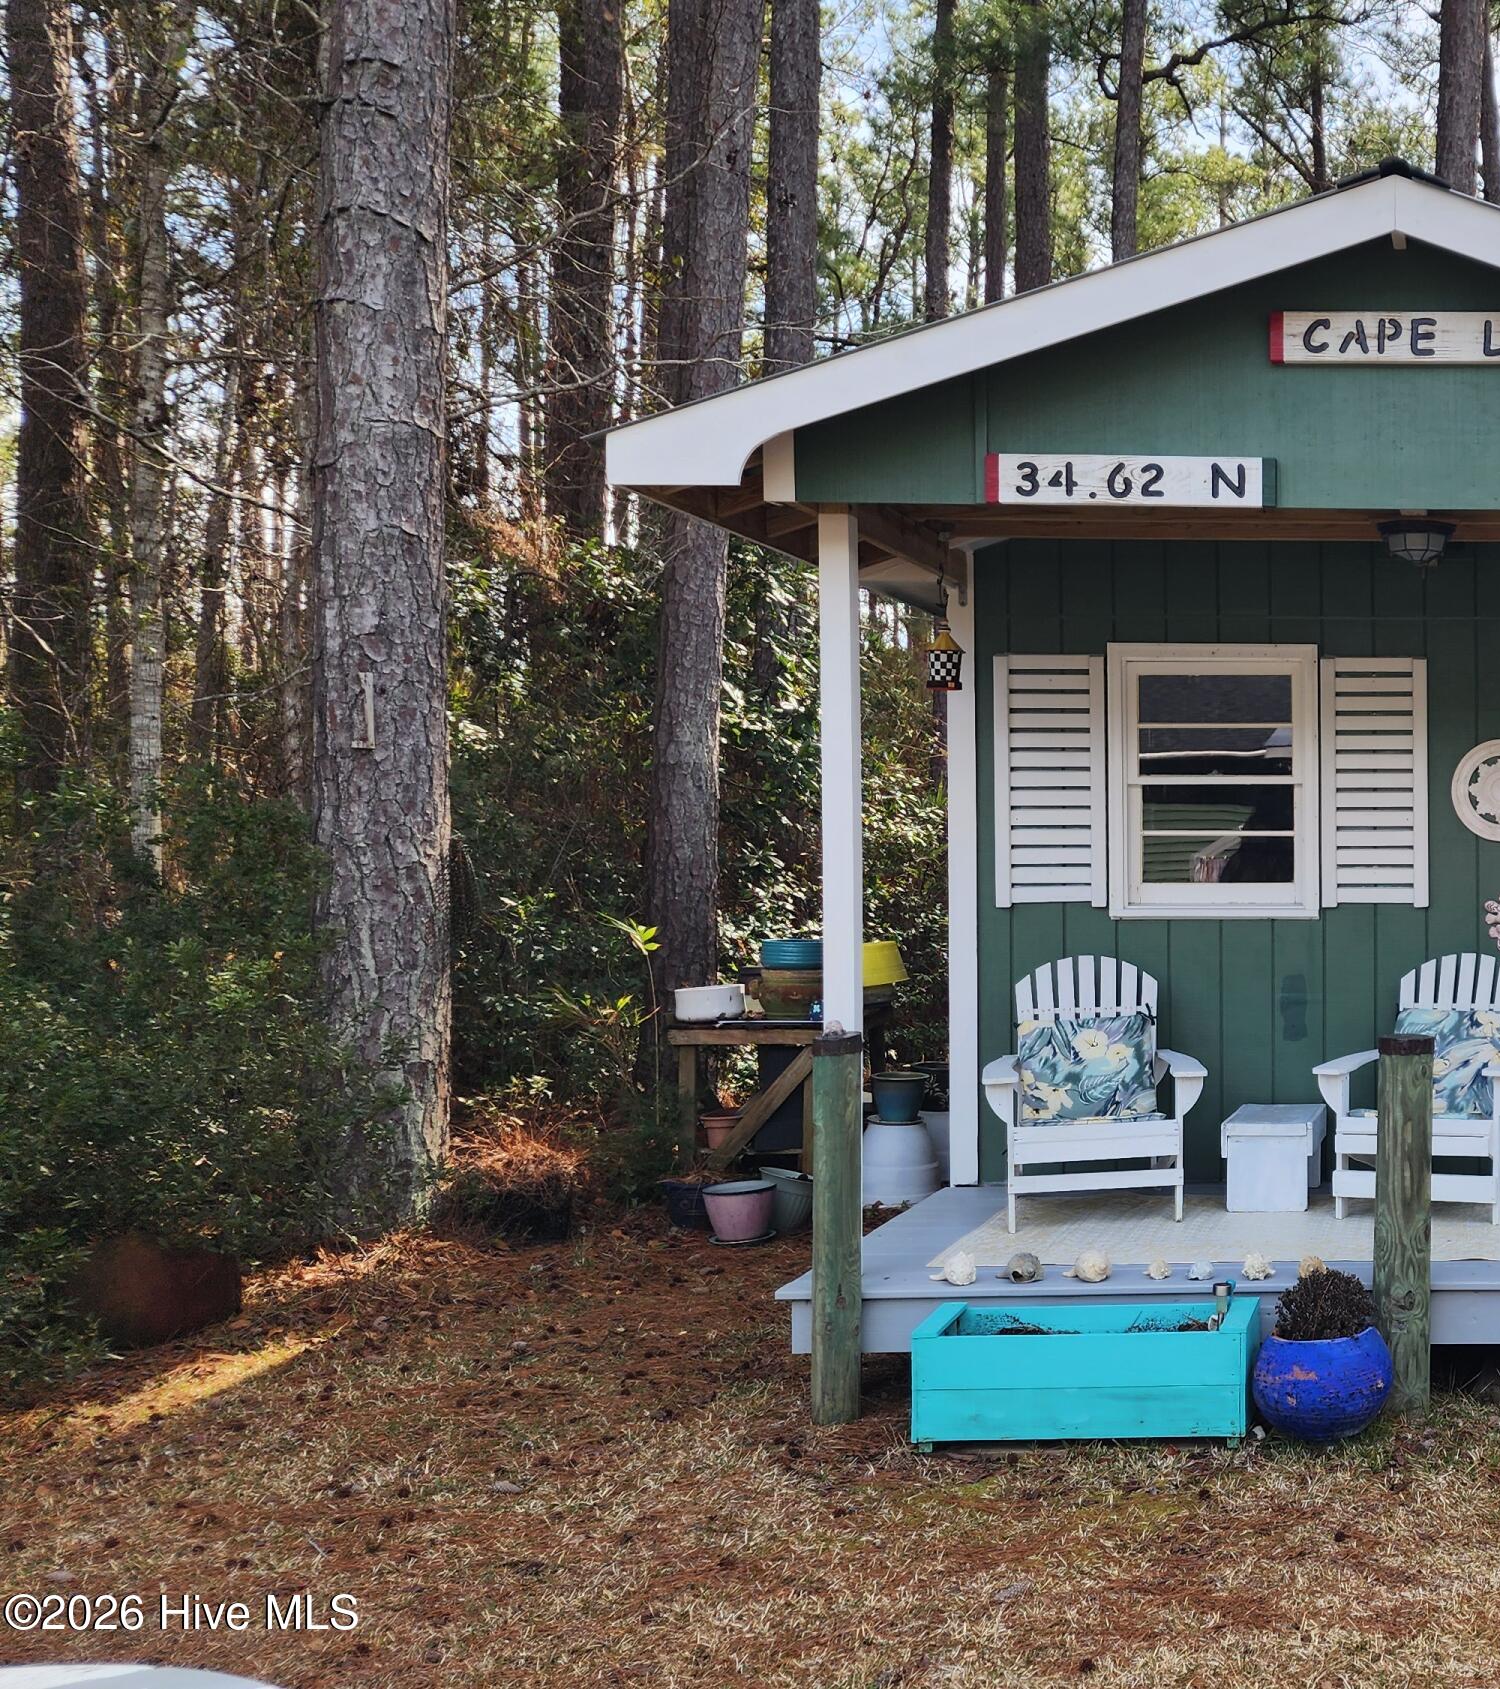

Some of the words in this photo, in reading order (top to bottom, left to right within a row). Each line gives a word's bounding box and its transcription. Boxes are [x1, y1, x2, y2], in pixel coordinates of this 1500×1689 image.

[1302, 317, 1438, 357] CAPE
[1015, 461, 1165, 500] 34.62
[1210, 462, 1246, 499] N
